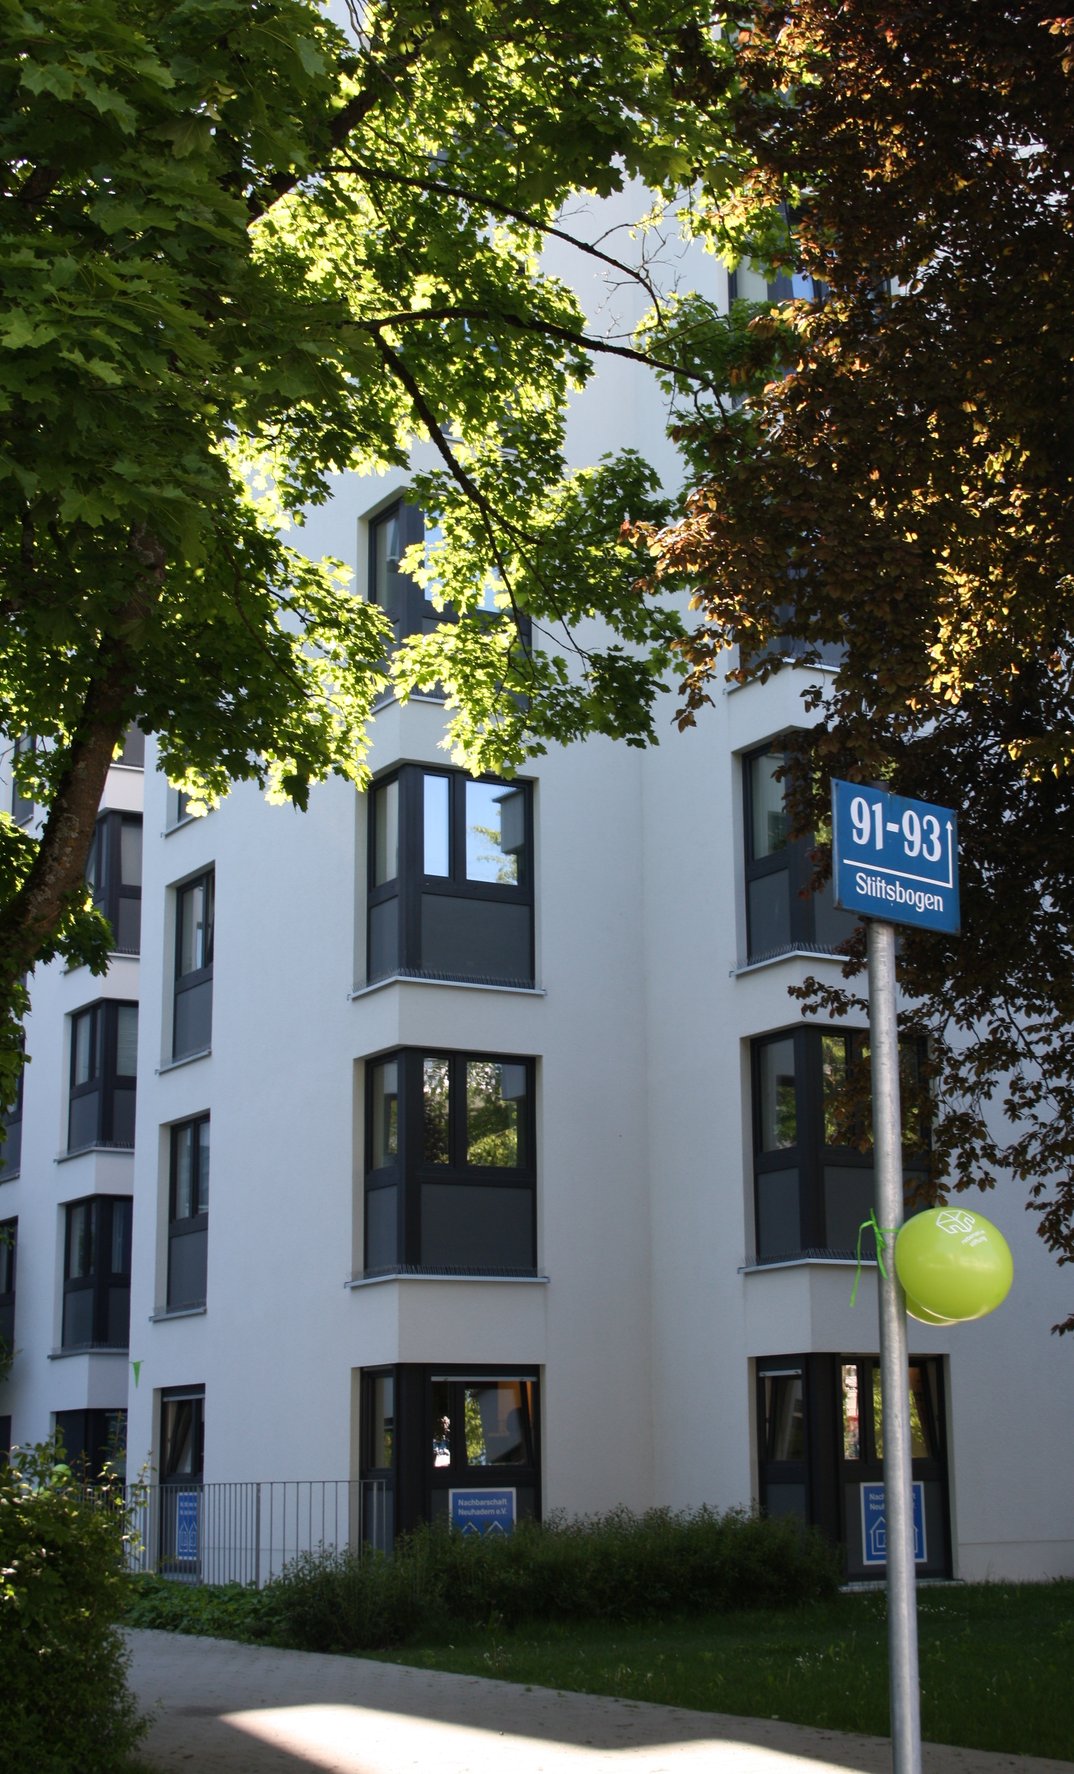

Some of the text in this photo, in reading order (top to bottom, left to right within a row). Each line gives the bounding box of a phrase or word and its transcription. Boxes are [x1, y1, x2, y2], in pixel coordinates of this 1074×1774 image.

[850, 796, 942, 862] 91-93
[856, 872, 944, 912] Stiftsbogen
[458, 1498, 507, 1506] Nachbarschaft
